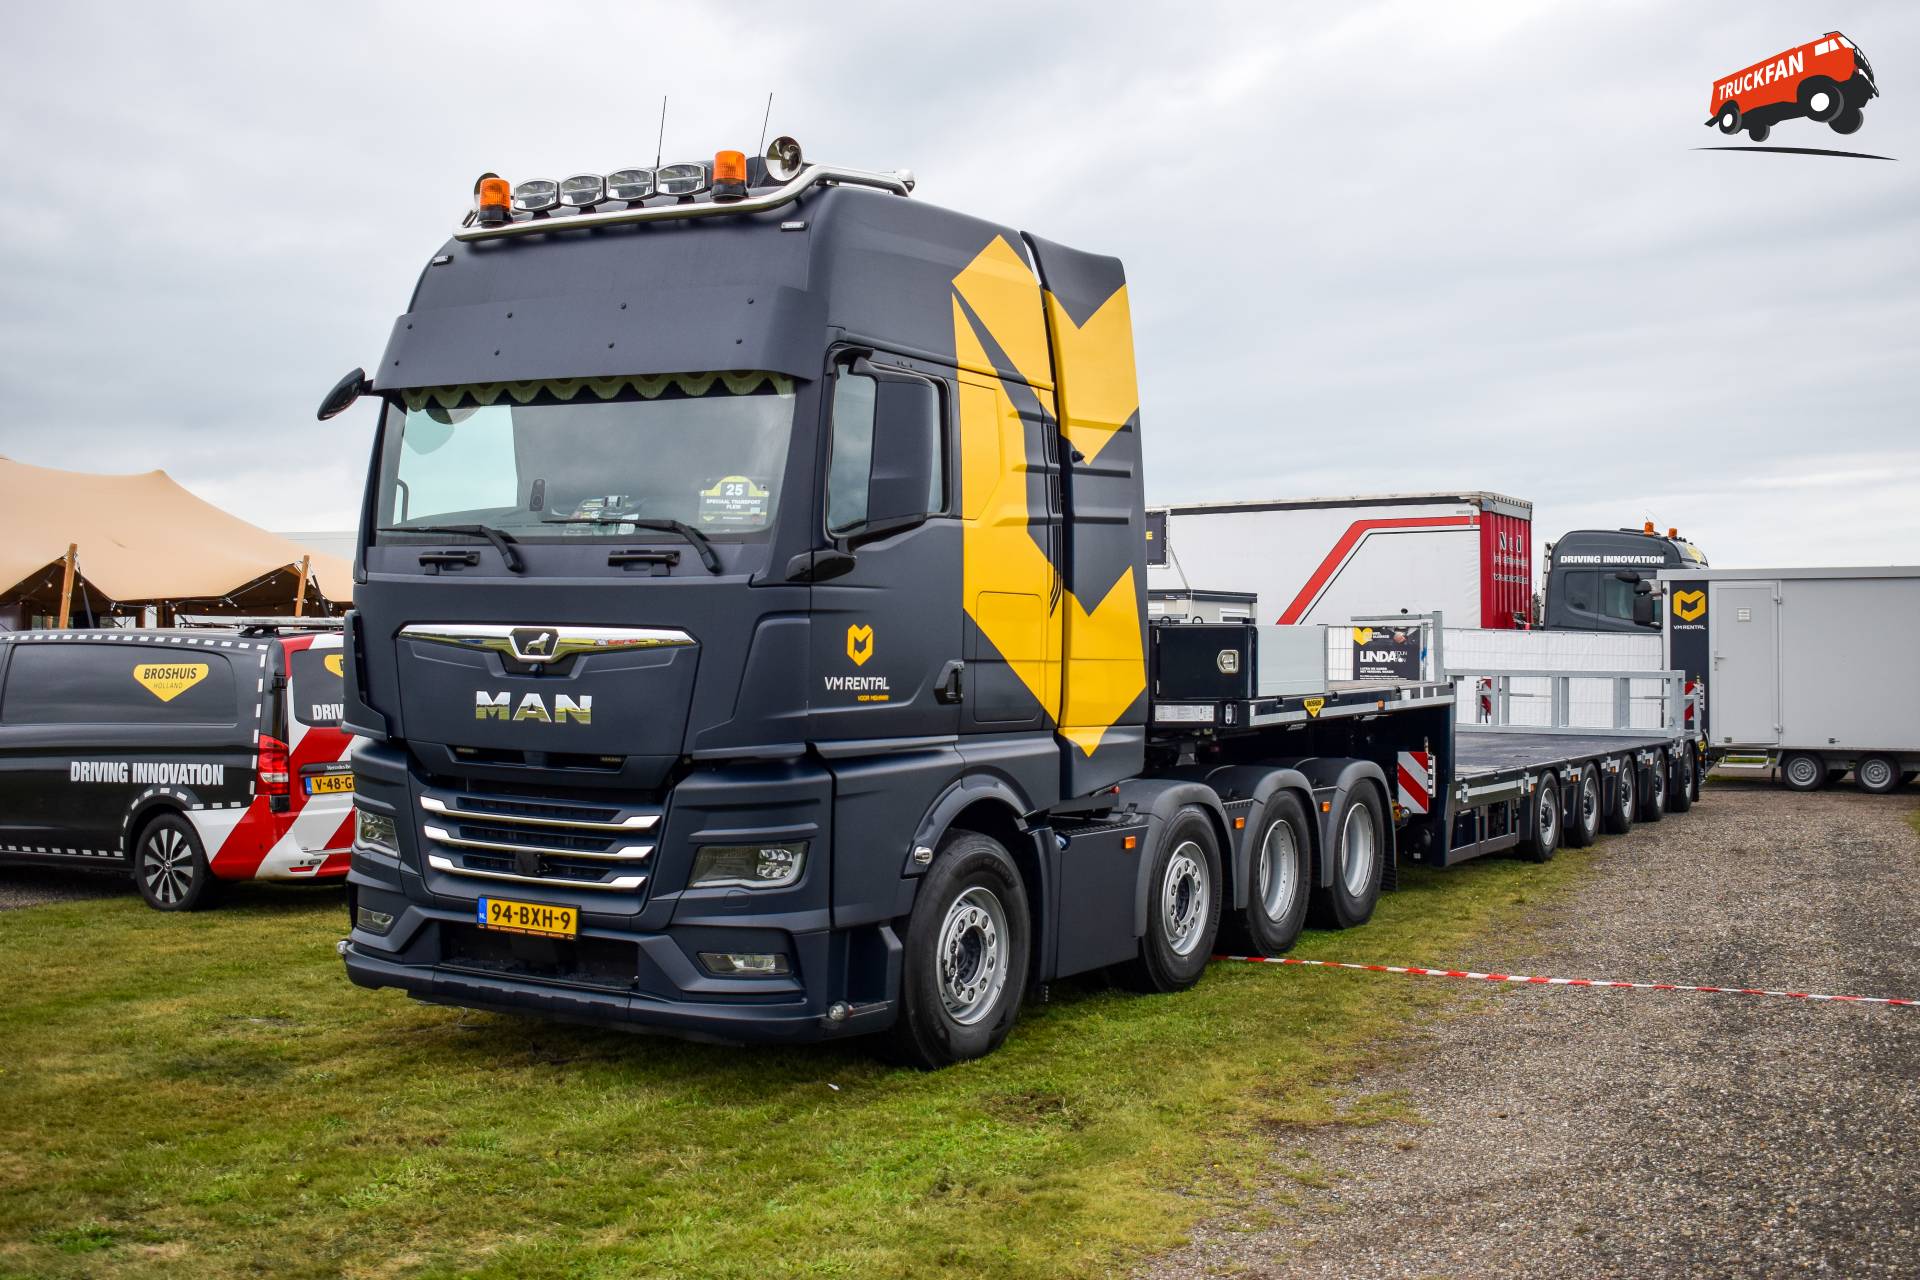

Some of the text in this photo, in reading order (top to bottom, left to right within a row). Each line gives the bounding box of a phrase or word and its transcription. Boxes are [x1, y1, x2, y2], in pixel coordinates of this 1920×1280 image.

[725, 484, 743, 496] 25
[1560, 555, 1665, 564] DRIVING INNOVATION
[1360, 650, 1395, 663] LINDA
[143, 667, 197, 681] BROSHUIS
[153, 682, 183, 690] HOLLAND
[824, 676, 890, 691] VM RENTAL
[475, 690, 593, 724] MAN
[70, 761, 224, 786] DRIVING INNOVATION
[491, 903, 571, 930] 94-BXH-9
